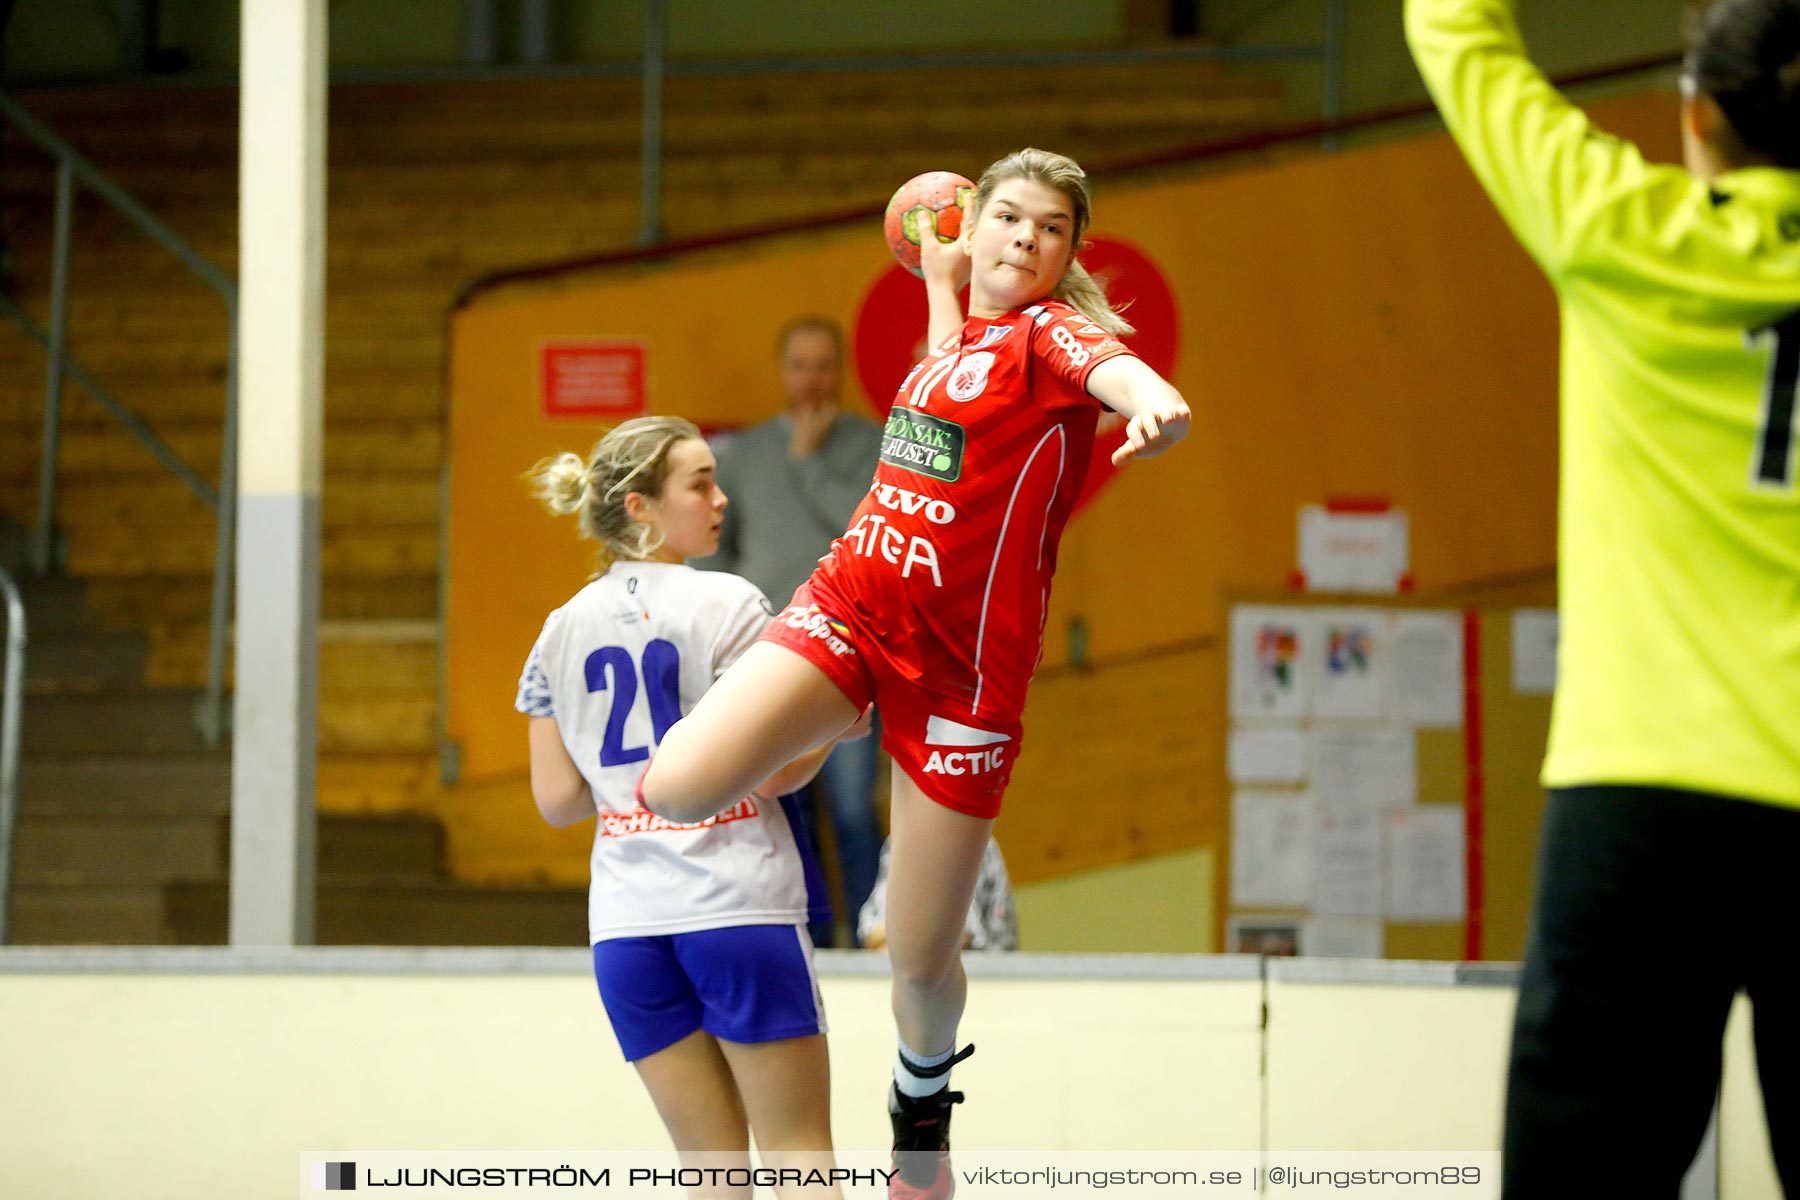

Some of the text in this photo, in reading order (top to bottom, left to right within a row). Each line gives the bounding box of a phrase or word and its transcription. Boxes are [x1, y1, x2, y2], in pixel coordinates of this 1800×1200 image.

[1052, 326, 1090, 367] coop
[884, 438, 939, 467] HUSET
[584, 638, 683, 768] 20
[922, 746, 1004, 776] ACTIC
